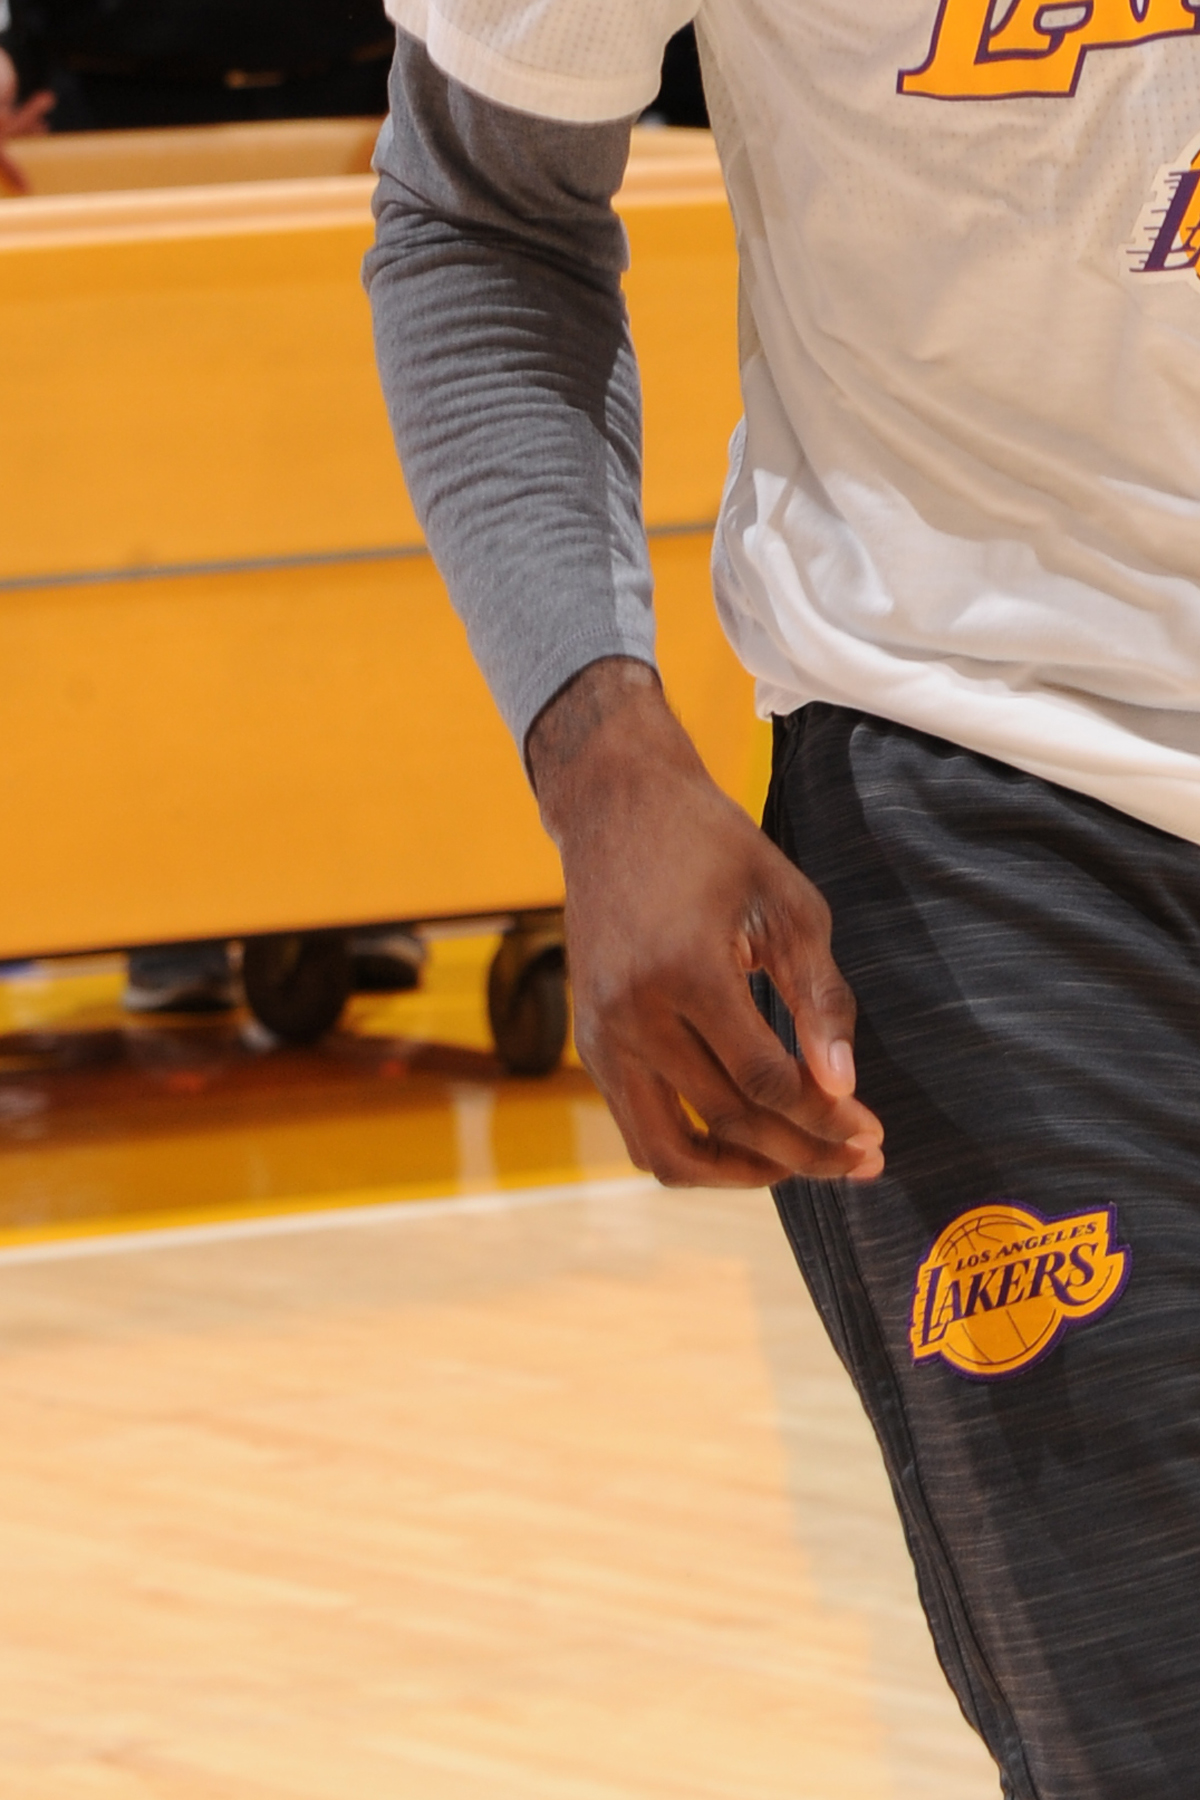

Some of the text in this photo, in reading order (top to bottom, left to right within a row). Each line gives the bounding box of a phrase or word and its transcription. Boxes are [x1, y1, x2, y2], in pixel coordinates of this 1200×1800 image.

[954, 1221, 1099, 1273] LOS ANGELES
[914, 1242, 1114, 1348] LAKERS
